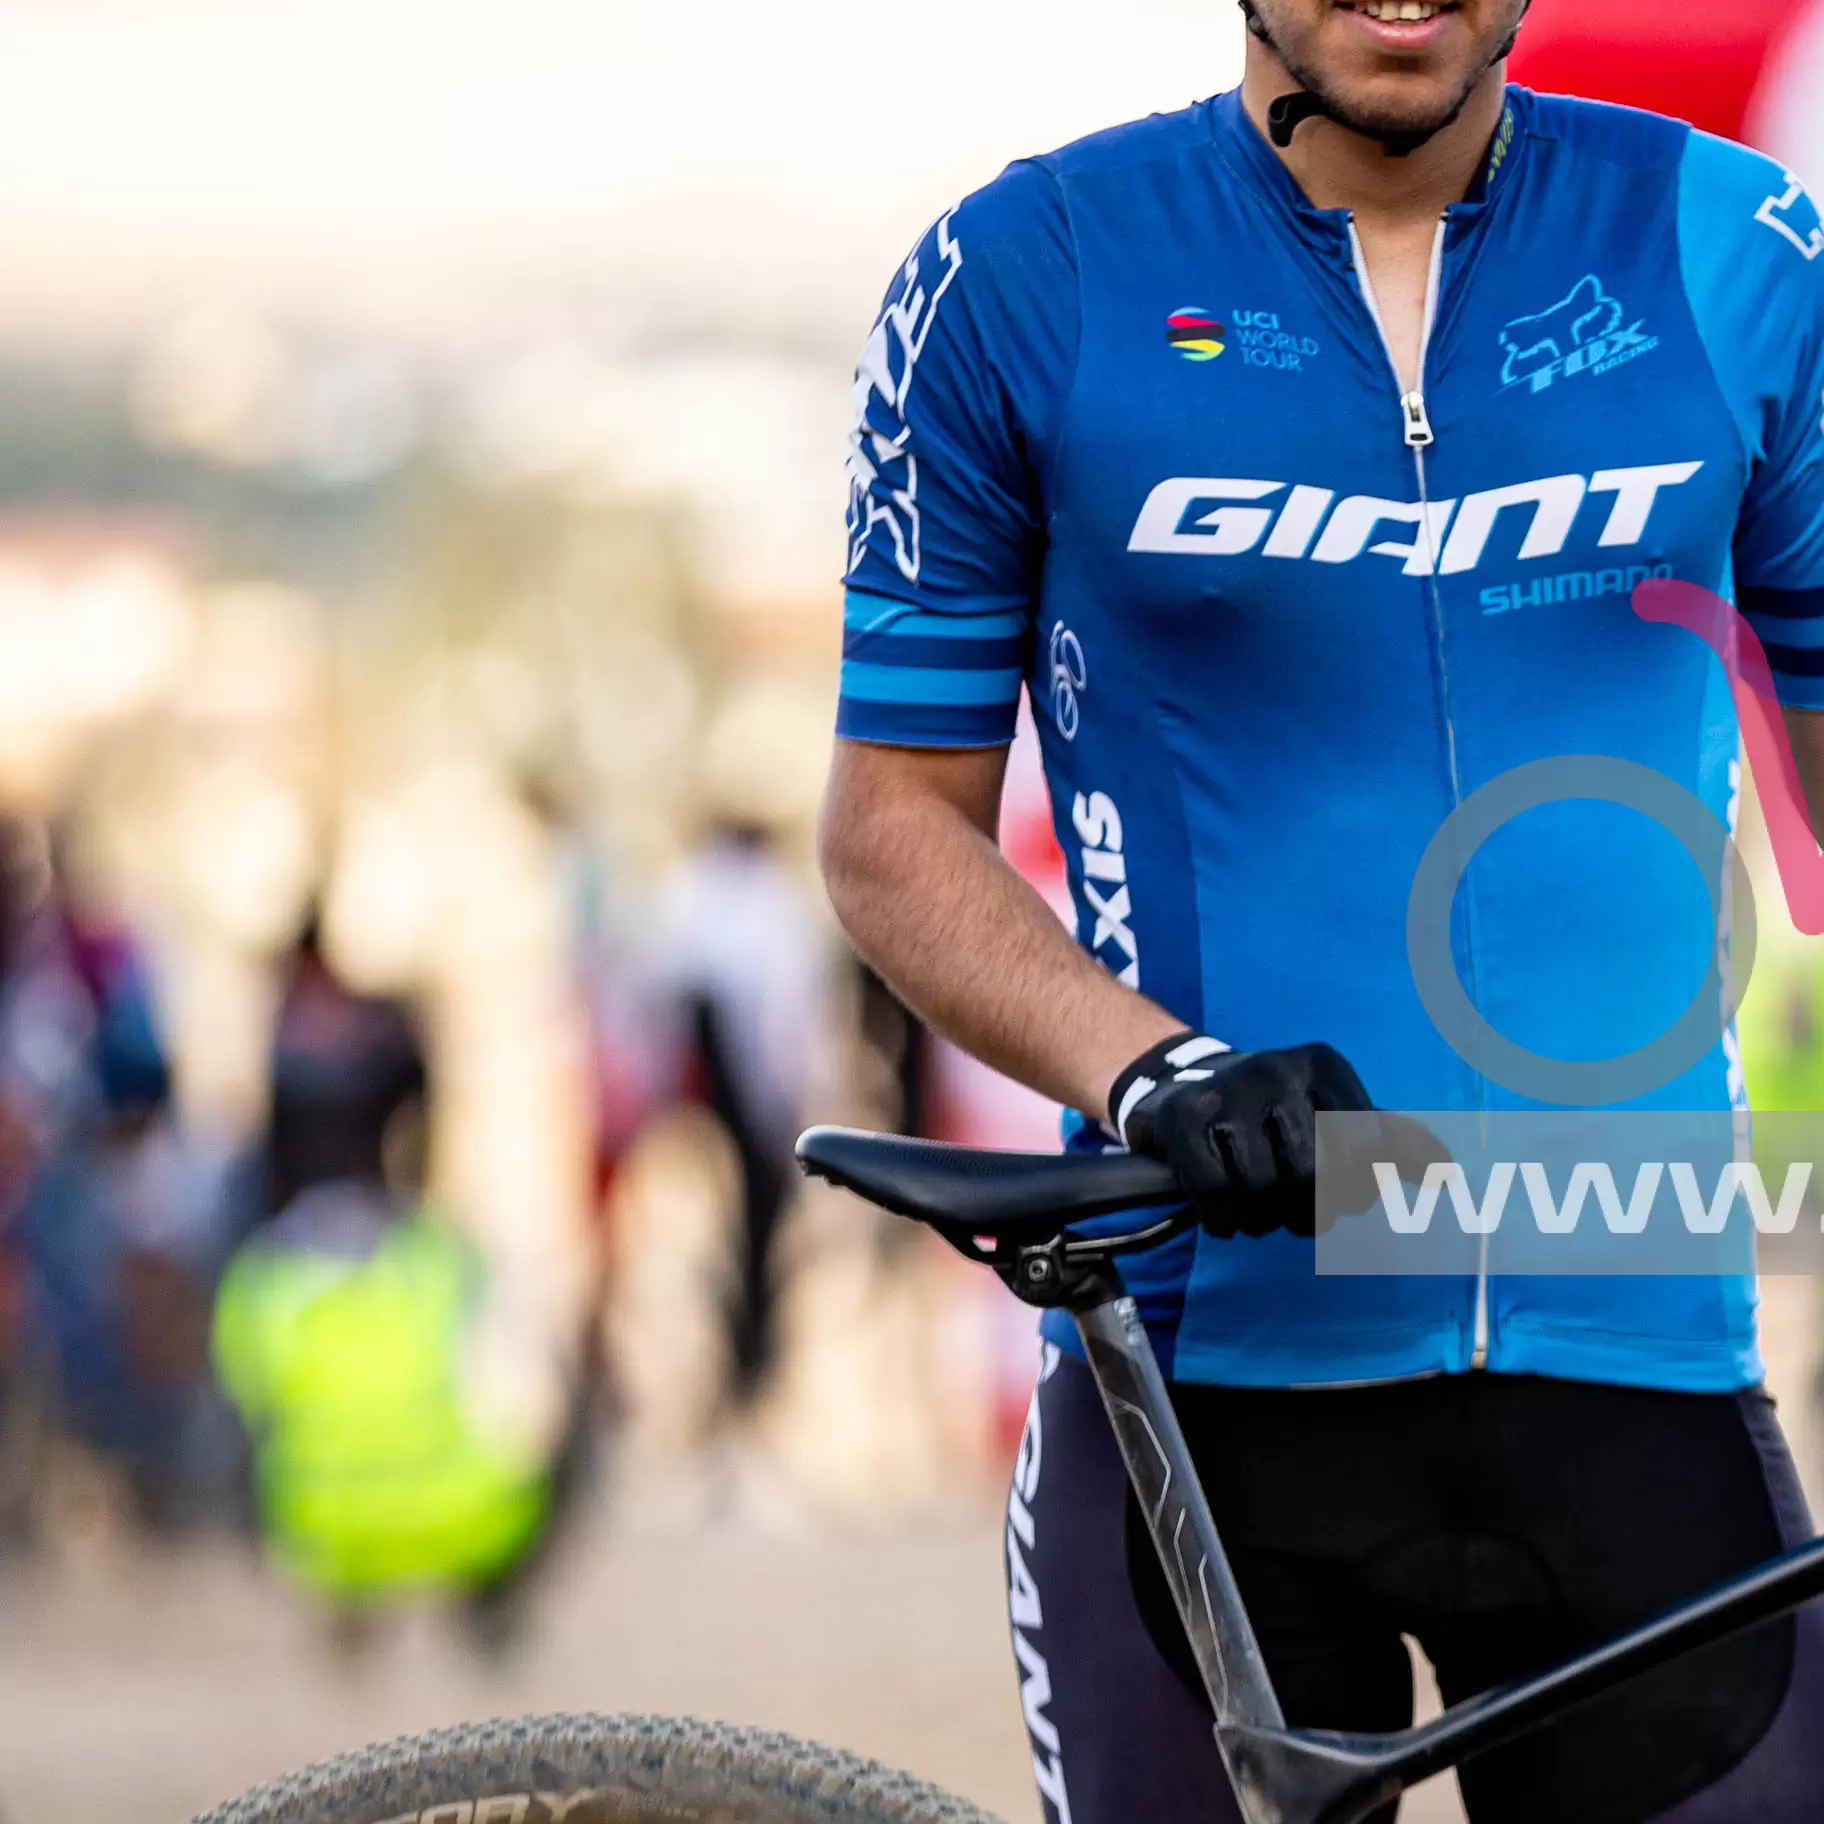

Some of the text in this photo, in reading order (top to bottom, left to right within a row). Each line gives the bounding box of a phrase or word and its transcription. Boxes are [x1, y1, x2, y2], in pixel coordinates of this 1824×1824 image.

[1231, 308, 1280, 331] UCI
[1235, 327, 1320, 357] WORLD
[1239, 346, 1304, 374] TOUR
[1490, 317, 1650, 397] FOX
[1127, 459, 1704, 576] GIANT
[1479, 562, 1674, 617] SHIMANO
